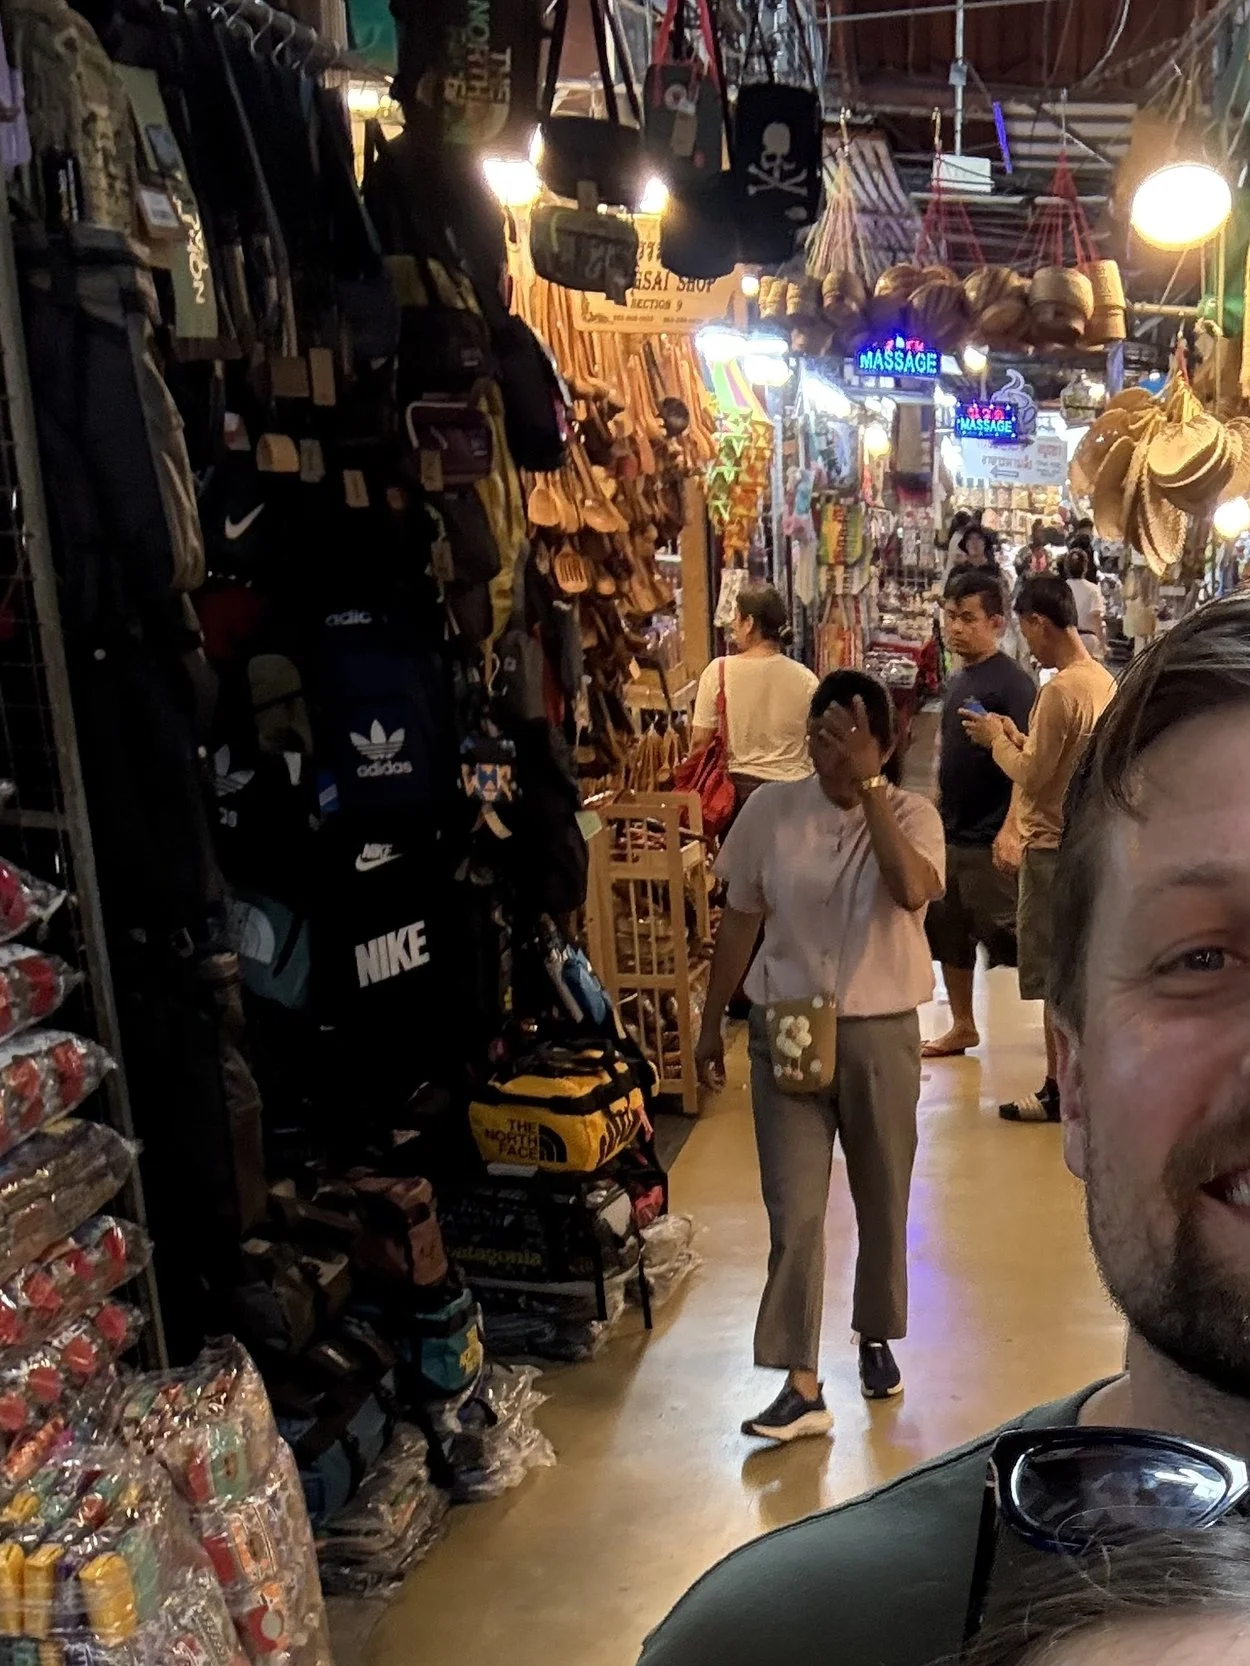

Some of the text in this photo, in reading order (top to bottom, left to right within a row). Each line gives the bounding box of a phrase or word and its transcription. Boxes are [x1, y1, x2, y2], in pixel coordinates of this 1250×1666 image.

[859, 348, 938, 374] MASSAGE
[960, 417, 1013, 433] MASSAGE
[356, 760, 413, 779] adidas
[361, 841, 394, 860] NIKE
[354, 918, 431, 988] NIKE
[509, 1118, 539, 1131] THE
[484, 1128, 539, 1147] NORTH
[500, 1143, 539, 1160] FACE
[447, 1246, 543, 1269] atagonia
